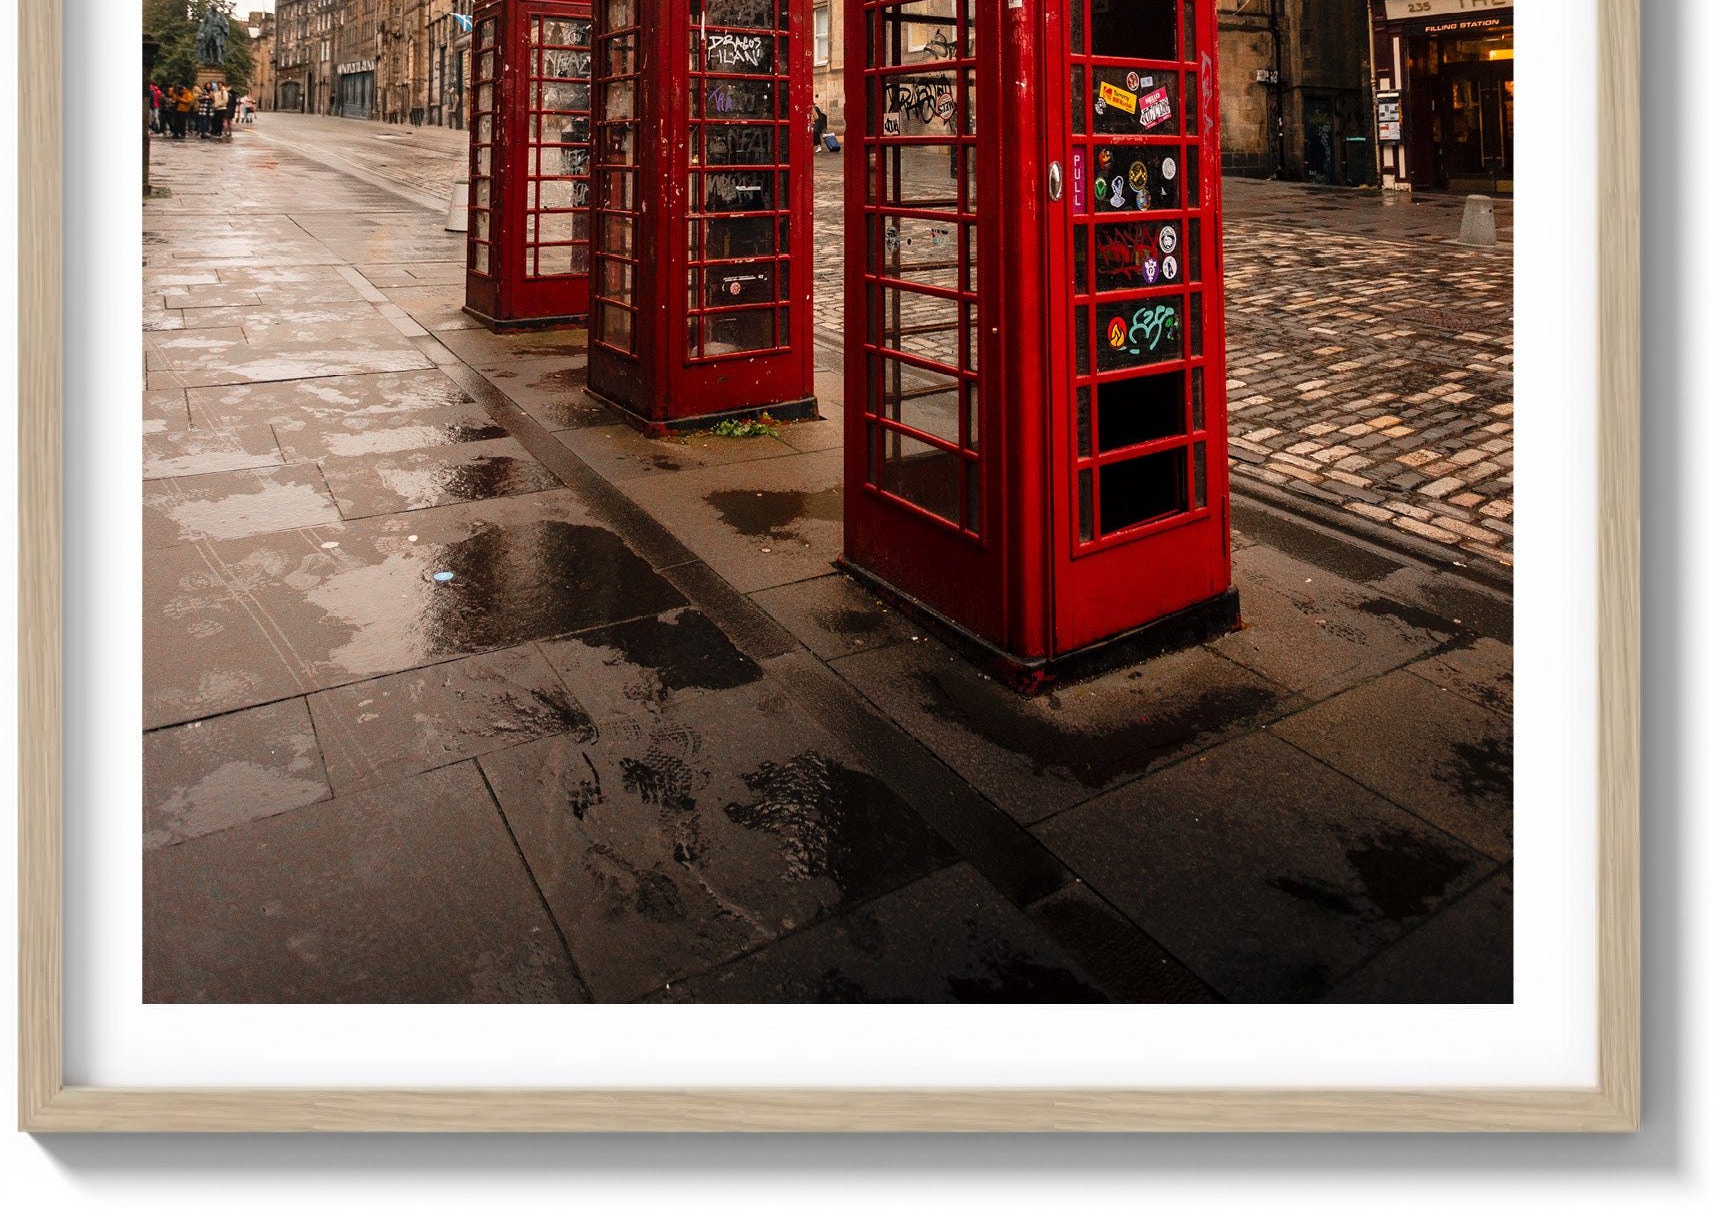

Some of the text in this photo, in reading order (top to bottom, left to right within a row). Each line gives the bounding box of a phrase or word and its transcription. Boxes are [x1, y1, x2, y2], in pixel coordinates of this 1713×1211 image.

[1407, 1, 1431, 13] 235
[1425, 19, 1500, 33] FILLING STATION
[1073, 154, 1082, 206] PULL
